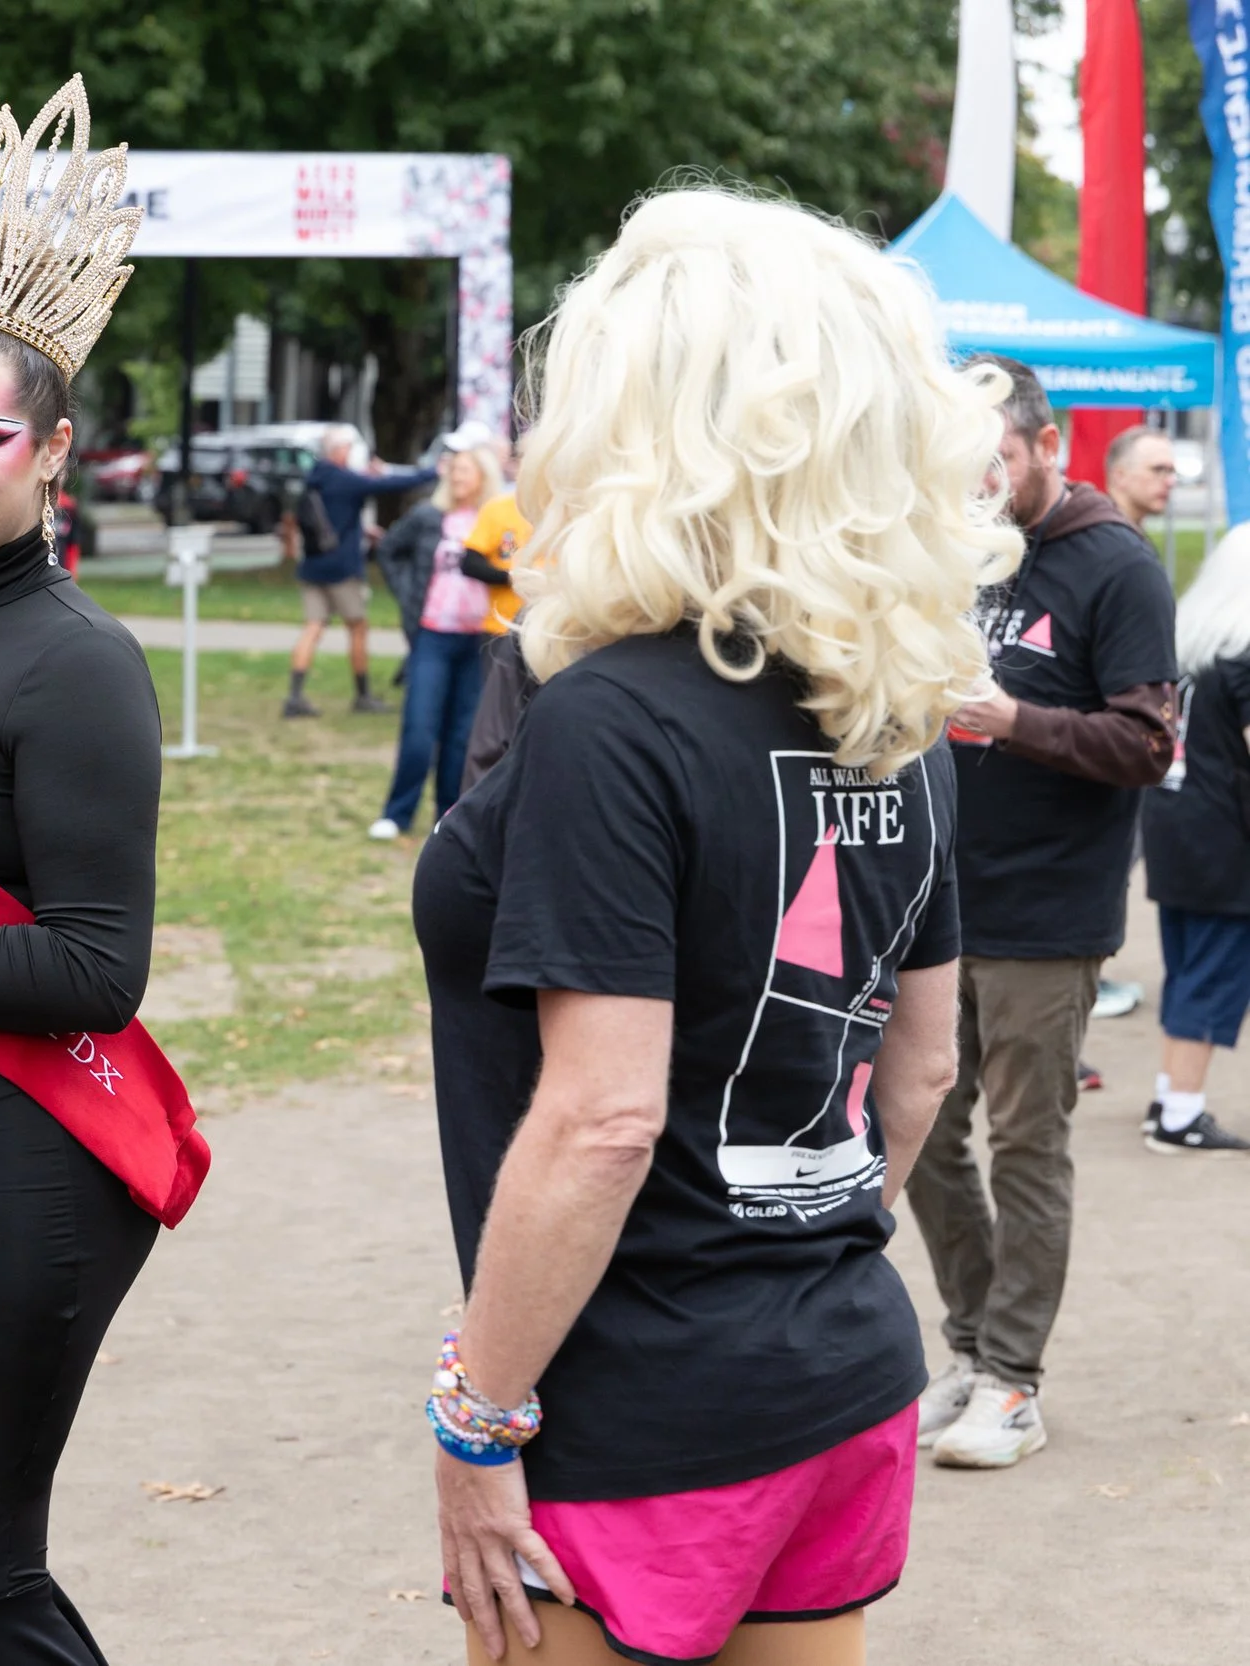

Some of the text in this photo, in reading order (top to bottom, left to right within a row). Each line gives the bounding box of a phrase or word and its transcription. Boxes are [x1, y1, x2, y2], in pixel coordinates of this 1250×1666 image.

[810, 767, 831, 786] ALL
[811, 789, 905, 846] LIFE
[49, 1032, 124, 1095] DX
[745, 1204, 787, 1218] GILEAD
